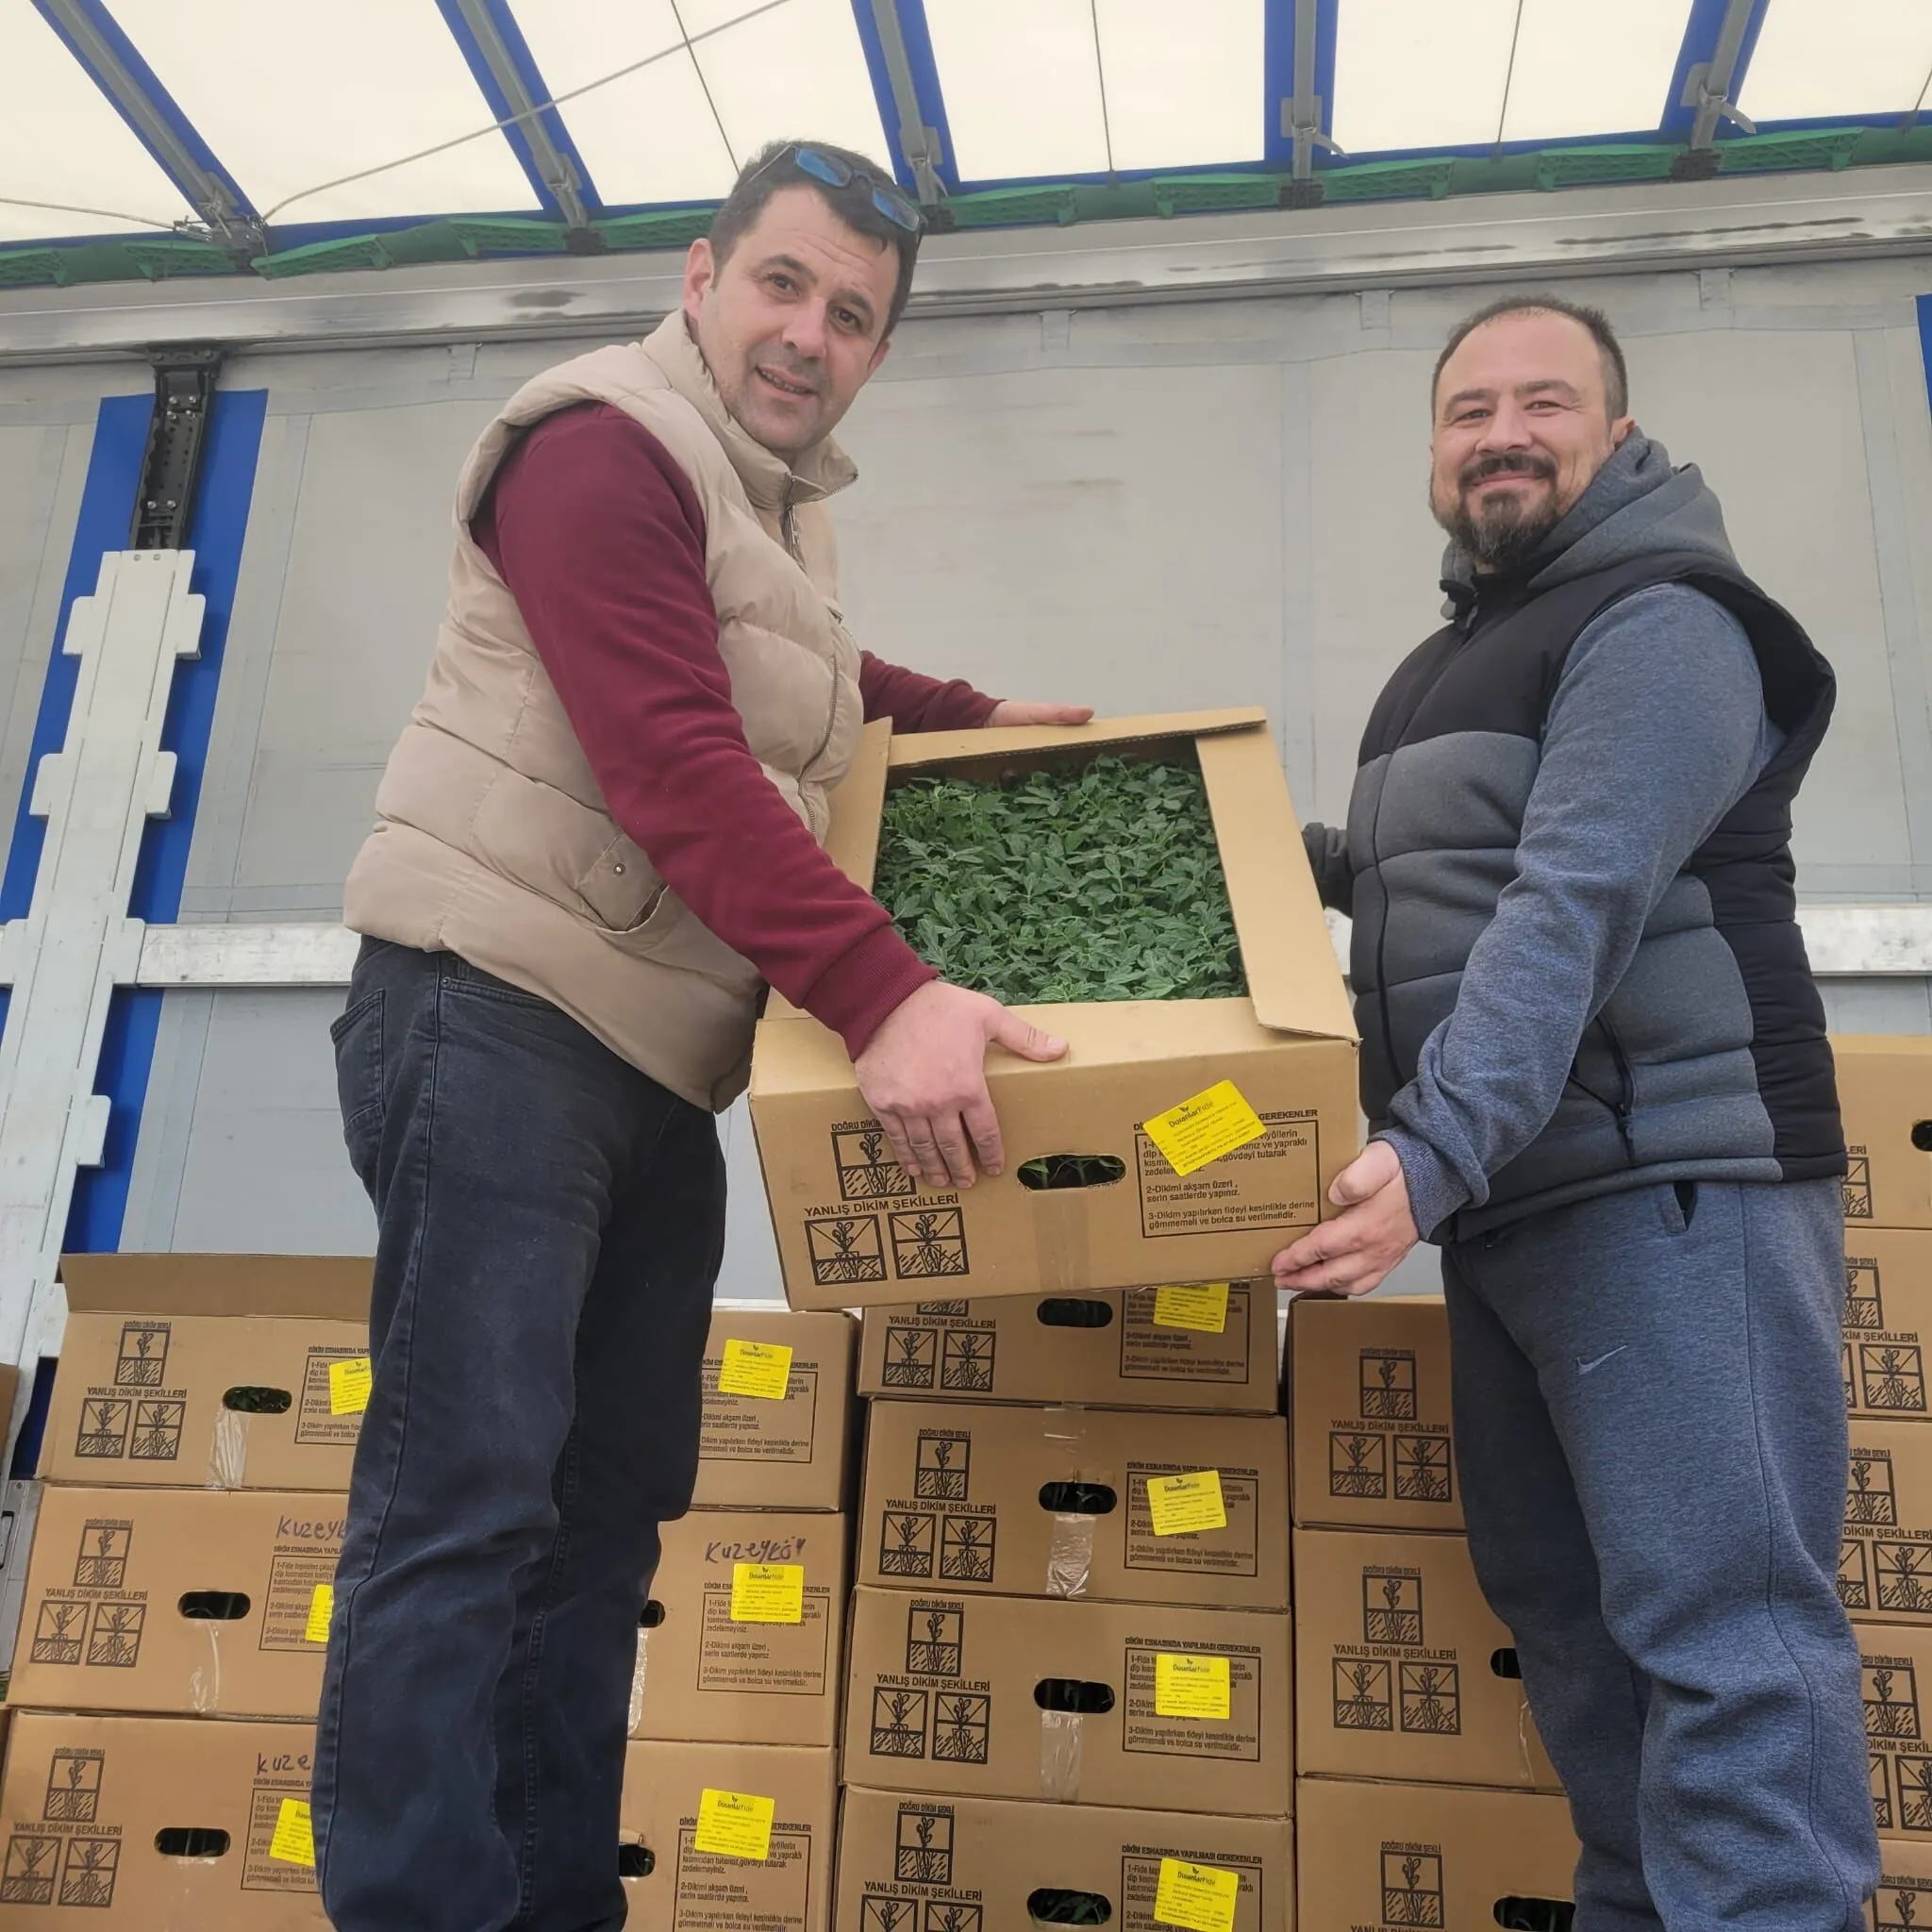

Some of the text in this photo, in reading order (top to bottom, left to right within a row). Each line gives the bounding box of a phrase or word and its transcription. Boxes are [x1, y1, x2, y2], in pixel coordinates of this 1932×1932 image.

[832, 1120, 858, 1131] DOĞRU
[1143, 1150, 1157, 1159] dip
[1274, 1139, 1307, 1150] yapraklı
[1257, 1150, 1287, 1158] tutarak
[1147, 1180, 1233, 1193] 2-Dikimi akşam üzeri
[1147, 1190, 1240, 1203] serin saatlerde yapınız.
[805, 1192, 958, 1217] YANLIŞ DİKİM ŞEKİLLERİ
[1149, 1201, 1314, 1220] 3-Dikim yapılırken fideyi kesinlikle derine
[1149, 1219, 1197, 1230] gömmemeli
[1211, 1214, 1233, 1223] bolca
[1248, 1211, 1296, 1221] verilmelidir.
[1842, 1331, 1918, 1343] KİM ŞEKİLLERİ
[88, 1387, 187, 1398] YANLIŞ DİKİM ŞEKİLLERİ
[886, 1499, 996, 1514] YANLIŞ DİKİM ŞEKİLLERİ
[1843, 1525, 1874, 1537] DİKİM
[46, 1589, 75, 1598] YANLIŞ
[103, 1590, 148, 1600] ŞEKİLLERİ
[1334, 1644, 1457, 1660] YANLIŞ DİKİM ŞEKİLLERİ
[877, 1674, 990, 1691] YANLIŞ DİKİM ŞEKİLLERİ
[865, 1880, 981, 1901] YANLIŞ DİKİM ŞEKİLLERİ
